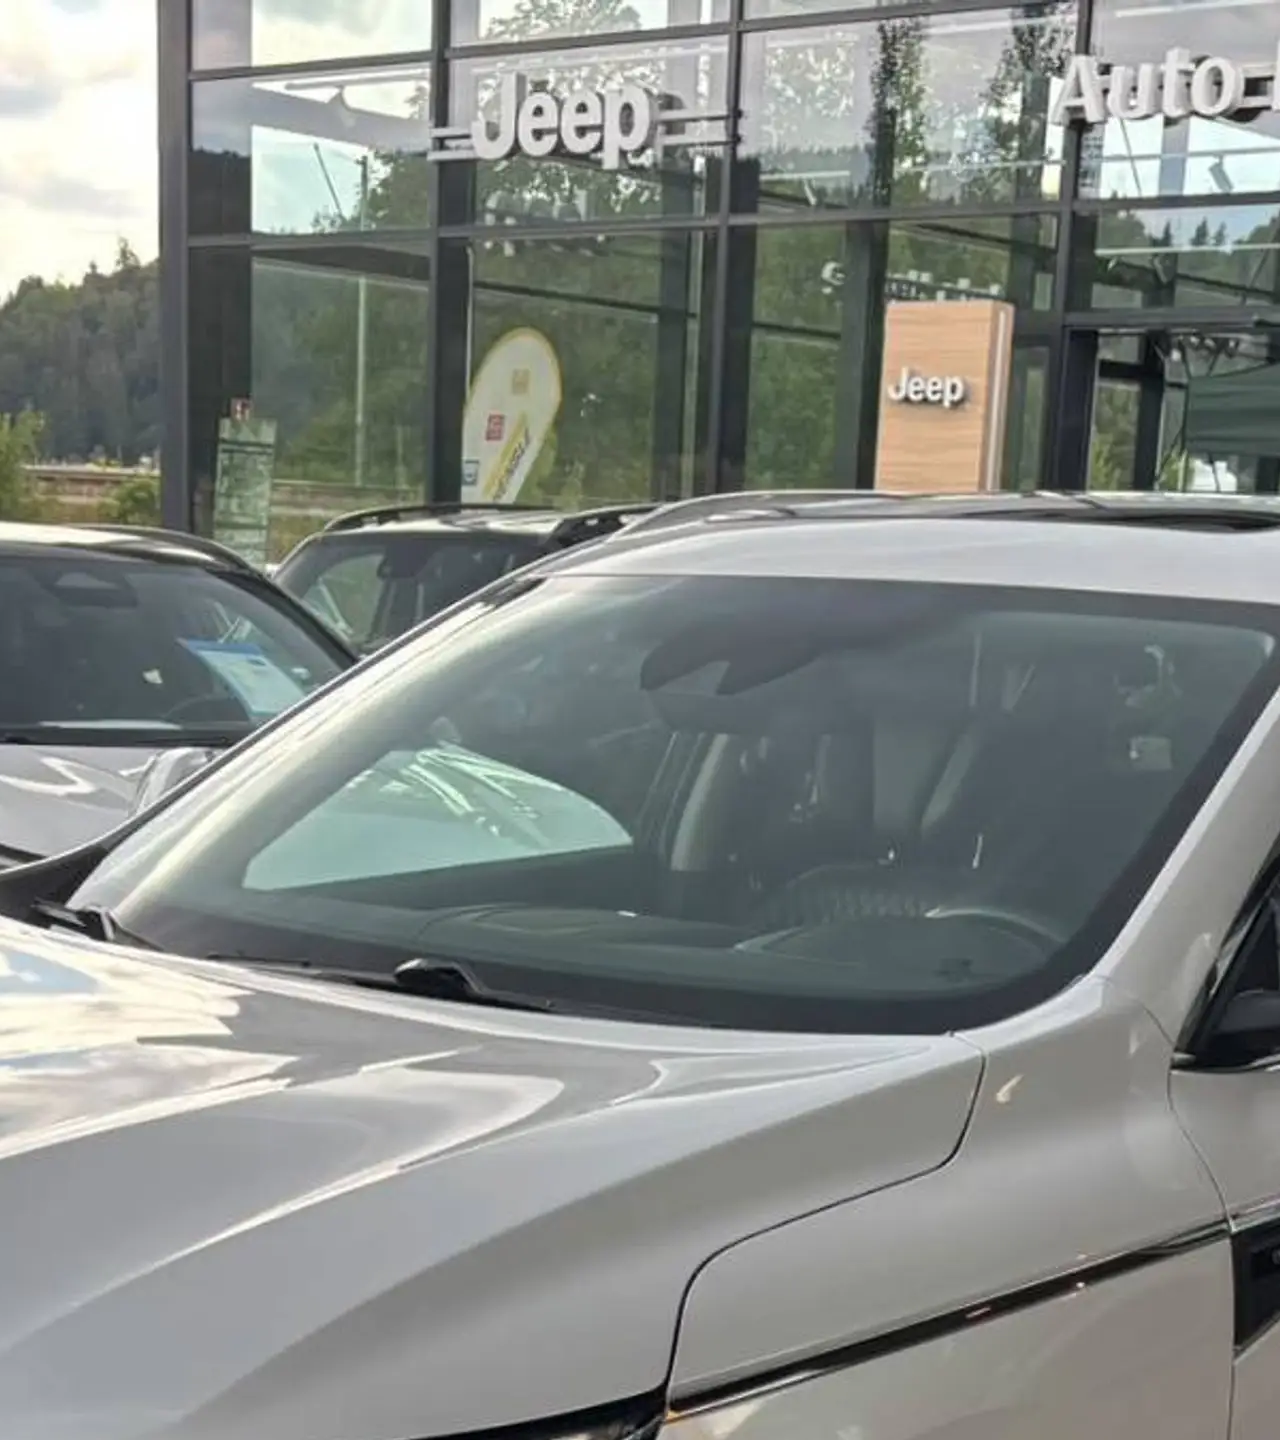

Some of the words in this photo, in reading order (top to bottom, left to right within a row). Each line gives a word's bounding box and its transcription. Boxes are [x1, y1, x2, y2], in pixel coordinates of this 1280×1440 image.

[471, 71, 651, 169] Jeep
[1051, 46, 1243, 124] Auto
[887, 367, 964, 408] Jeep
